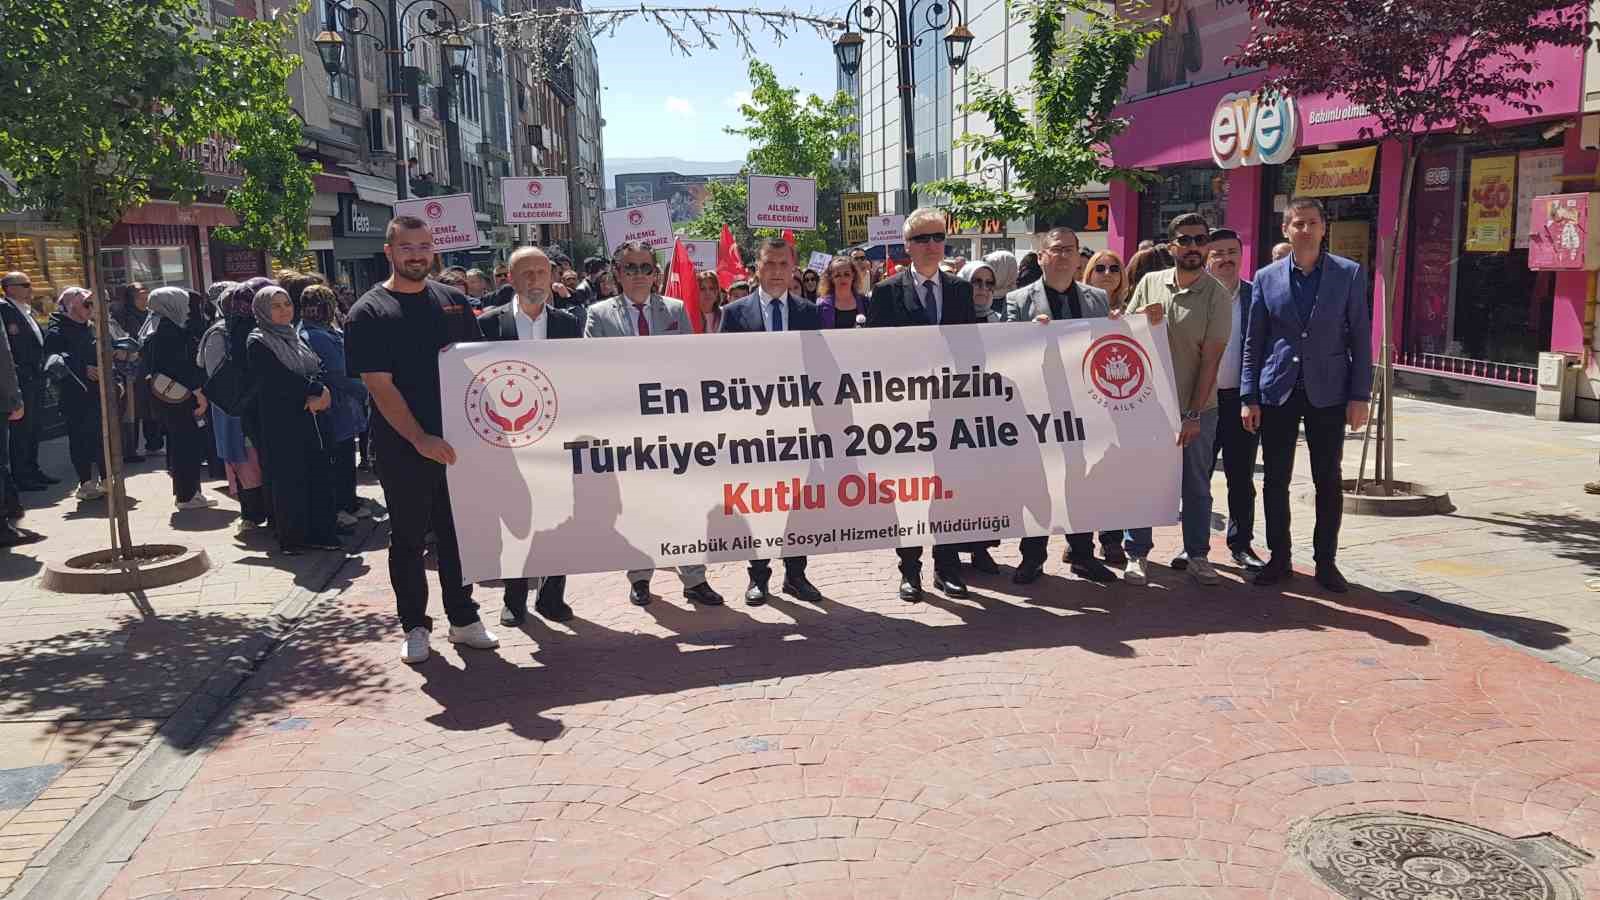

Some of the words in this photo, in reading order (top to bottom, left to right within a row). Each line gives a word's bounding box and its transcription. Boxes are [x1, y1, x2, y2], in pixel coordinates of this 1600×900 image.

[638, 382, 689, 416] En
[700, 374, 824, 416] Büyük
[834, 365, 1014, 406] Ailemizin,
[563, 426, 833, 475] Türkiye'mizin
[844, 421, 938, 457] 2025
[949, 416, 1019, 450] Aile
[1027, 410, 1086, 444] Yılı
[723, 478, 825, 516] Kutlu
[837, 472, 954, 508] Olsun.
[660, 537, 728, 557] Karabük
[731, 533, 762, 551] Aile
[765, 536, 784, 548] ve
[787, 529, 836, 549] Sosyal
[840, 524, 913, 543] Hizmetler
[915, 518, 927, 536] İl
[929, 514, 1010, 535] Müdürlüğü
